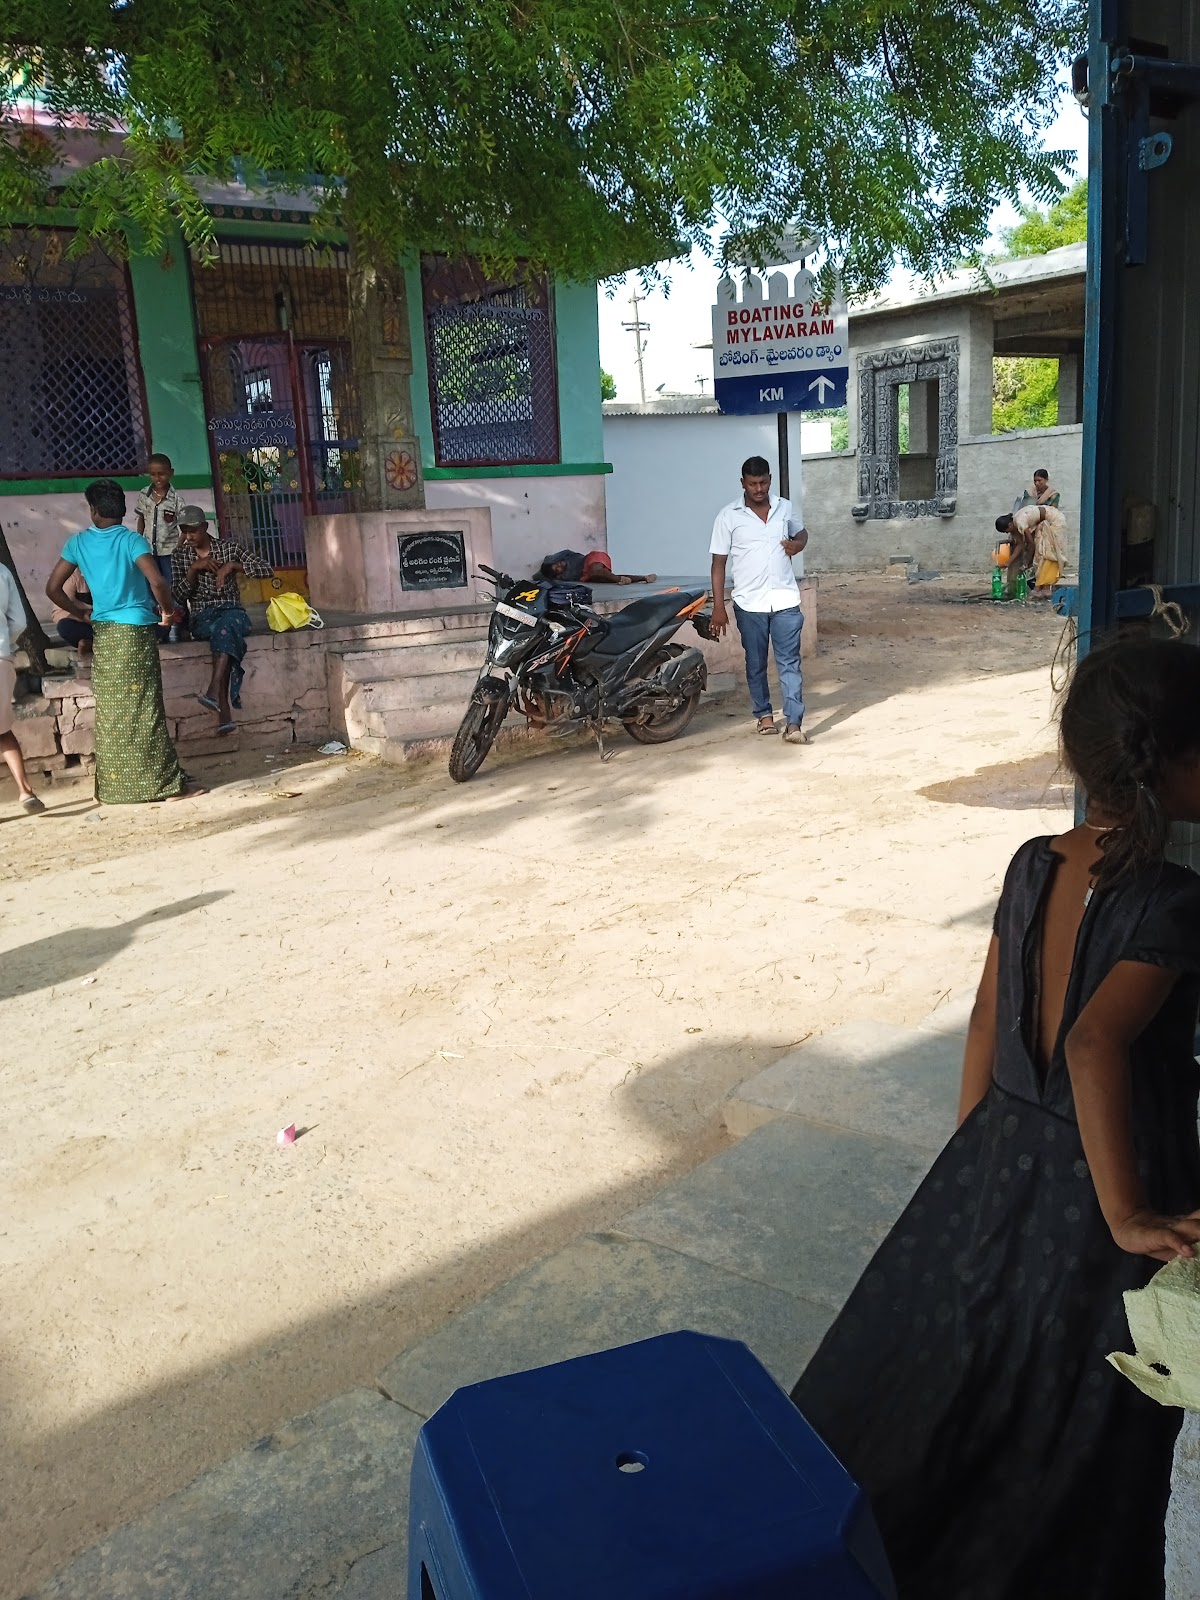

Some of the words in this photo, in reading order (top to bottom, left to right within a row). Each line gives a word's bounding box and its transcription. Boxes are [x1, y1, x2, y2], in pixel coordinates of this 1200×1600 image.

[727, 303, 804, 325] BOATING
[727, 319, 834, 344] MYLAVARAM
[759, 387, 784, 401] KM
